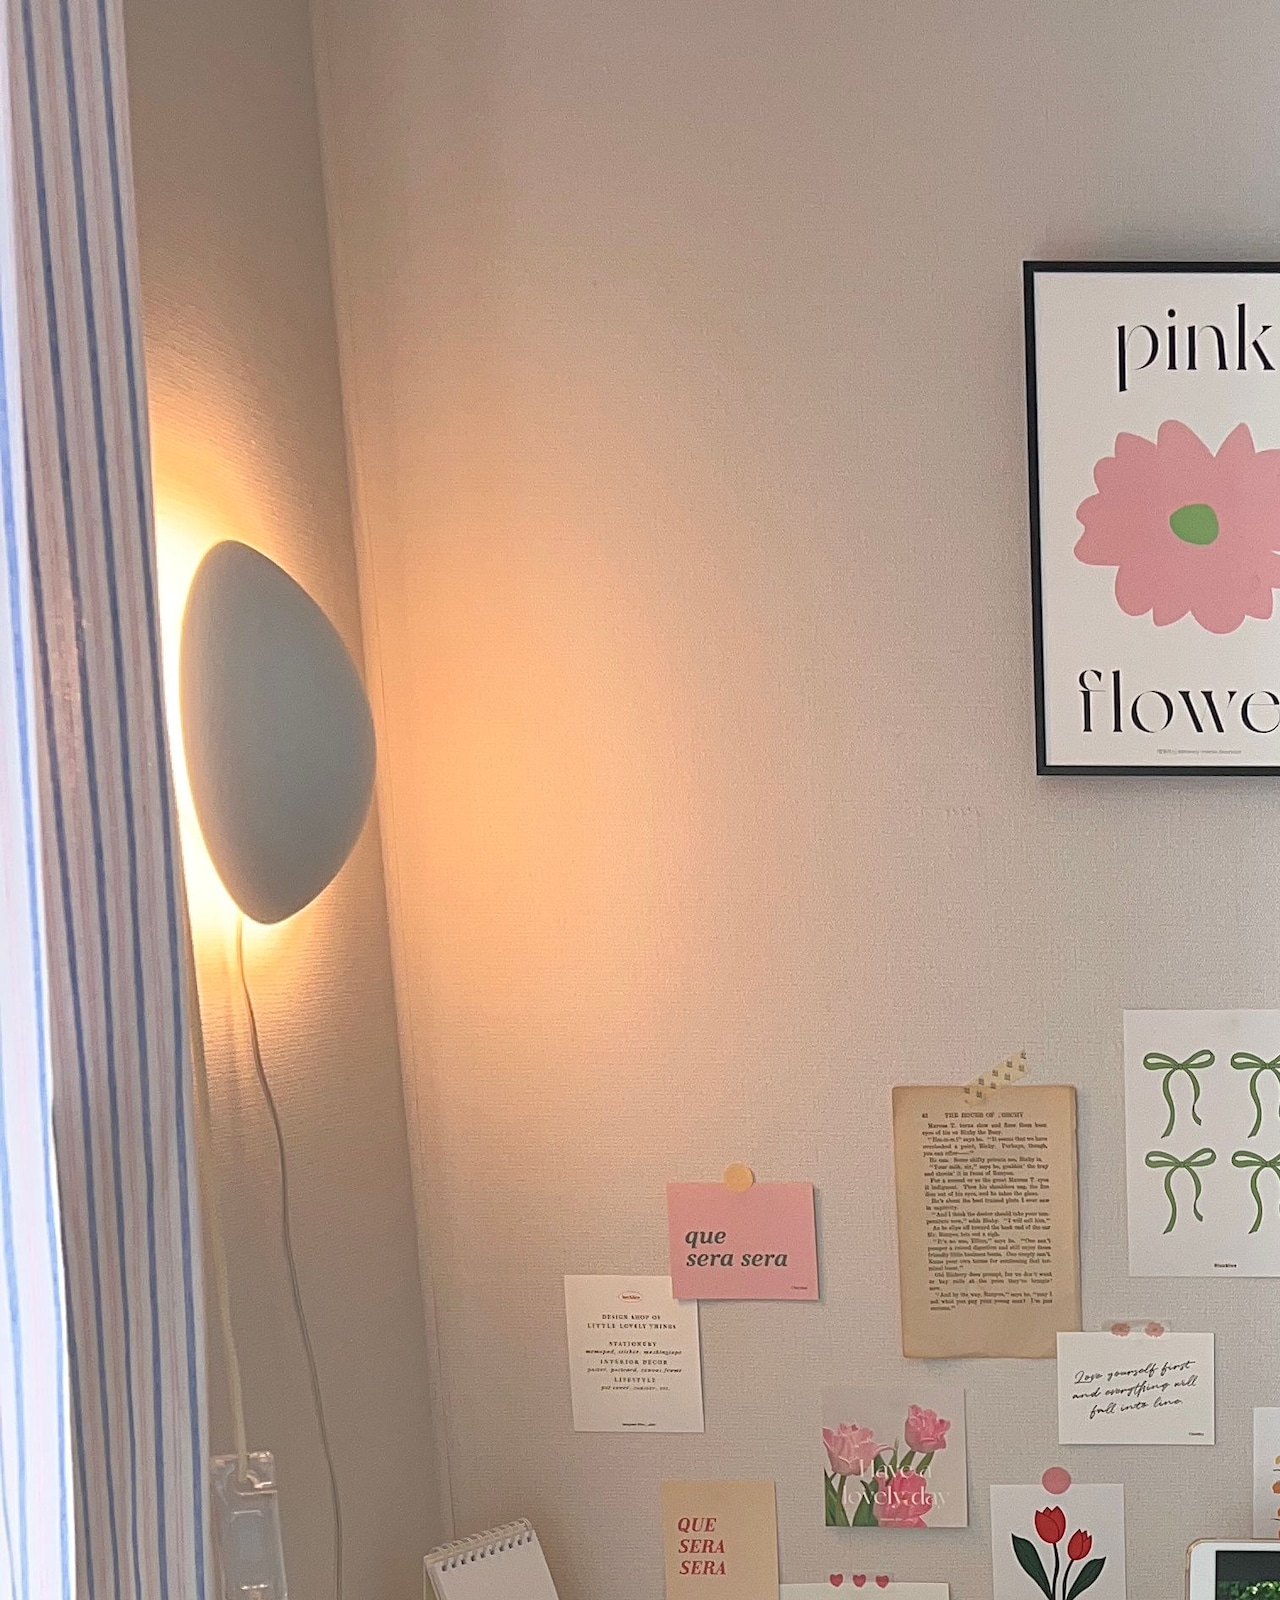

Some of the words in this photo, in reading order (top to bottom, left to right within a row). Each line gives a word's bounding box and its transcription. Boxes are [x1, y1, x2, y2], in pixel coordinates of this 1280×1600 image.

[1117, 303, 1275, 392] pink
[685, 1229, 726, 1248] que
[686, 1253, 733, 1267] sera
[740, 1253, 788, 1267] sera
[859, 1459, 914, 1479] Have
[919, 1464, 932, 1478] a
[843, 1485, 904, 1509] lovely
[911, 1485, 950, 1509] day
[677, 1517, 717, 1533] QUE
[678, 1539, 725, 1553] SERA
[679, 1561, 726, 1575] SERA
